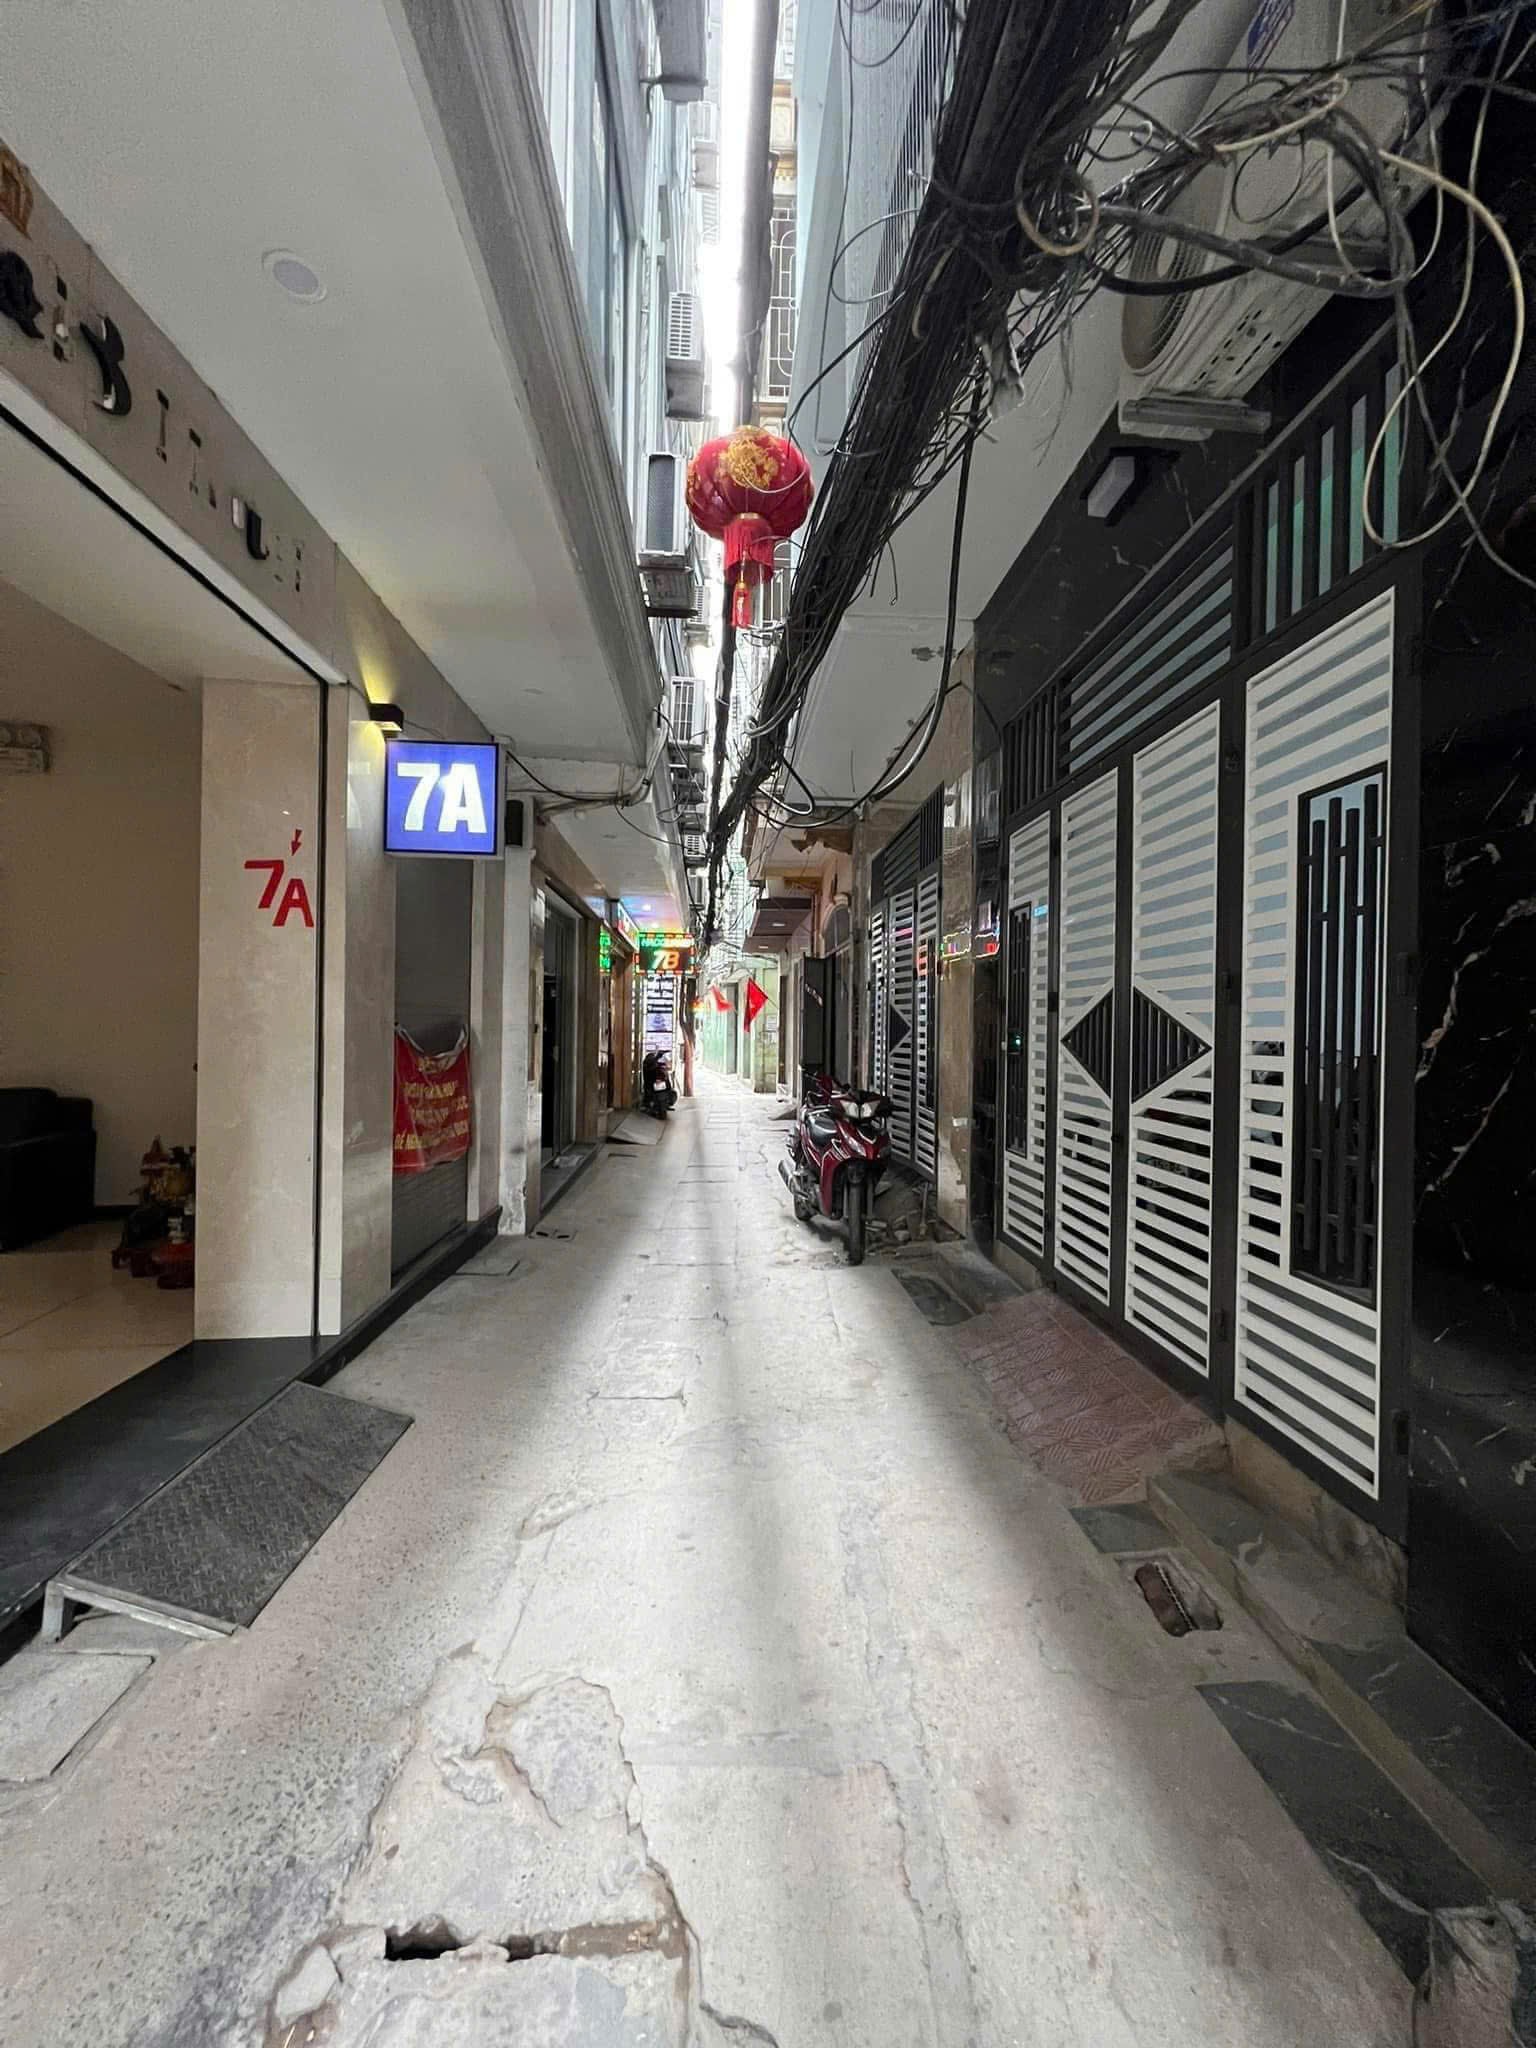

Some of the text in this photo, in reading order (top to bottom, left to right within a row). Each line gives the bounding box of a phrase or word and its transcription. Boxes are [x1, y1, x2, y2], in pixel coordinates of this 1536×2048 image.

[396, 763, 487, 834] 7A
[243, 859, 314, 927] 7A
[651, 949, 680, 970] 7B
